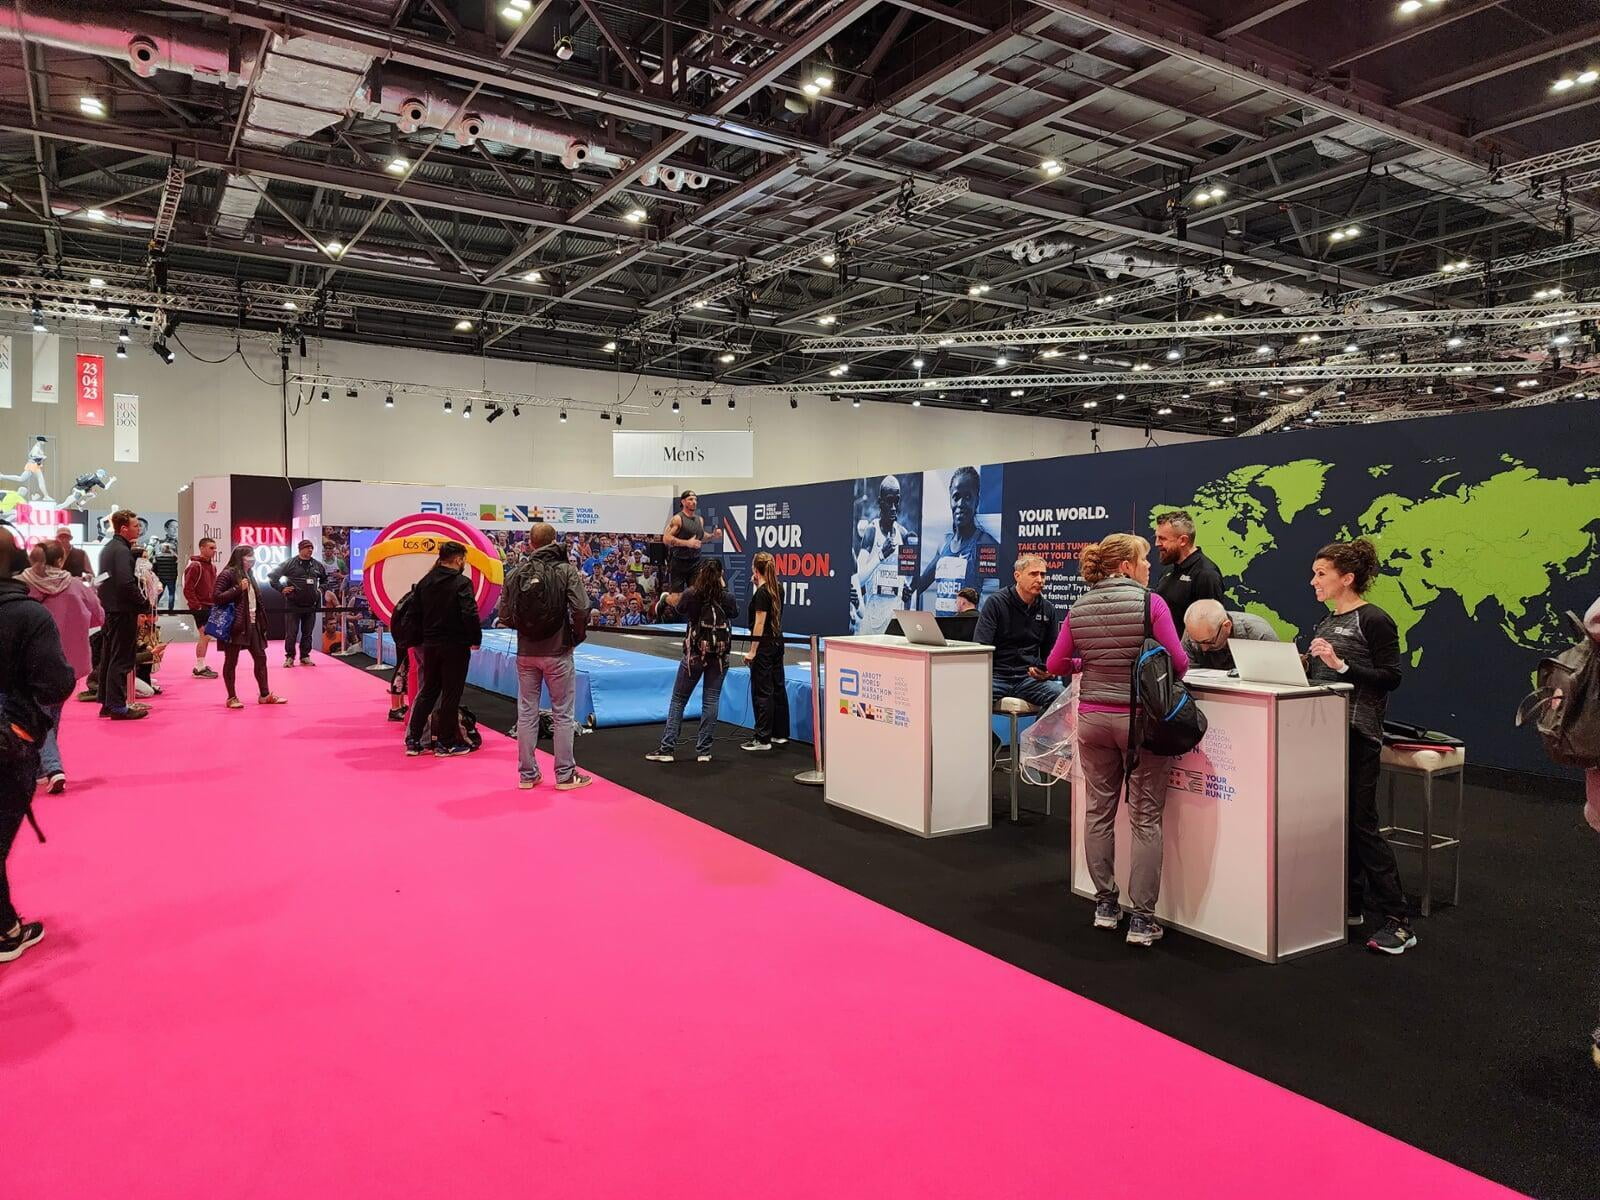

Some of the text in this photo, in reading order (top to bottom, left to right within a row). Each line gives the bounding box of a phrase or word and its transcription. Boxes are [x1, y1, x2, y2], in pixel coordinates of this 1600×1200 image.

[82, 362, 98, 375] 23
[82, 375, 98, 387] 04
[83, 387, 98, 400] 23
[664, 446, 705, 461] Men's
[1018, 506, 1109, 523] YOUR WORLD.
[203, 523, 222, 540] Run
[239, 526, 287, 546] RUN
[755, 525, 802, 548] YOUR
[1018, 523, 1061, 537] RUN IT.
[1018, 543, 1037, 551] TAKE
[1037, 542, 1049, 550] ON
[1050, 542, 1065, 550] THE
[254, 545, 287, 563] ON
[1050, 552, 1072, 560] YOUR
[773, 553, 835, 578] NDON.
[791, 582, 811, 606] IT.
[1072, 584, 1083, 593] Try
[1048, 592, 1069, 600] fastest
[1205, 774, 1227, 784] YOUR
[1205, 782, 1236, 794] WORLD.
[1205, 790, 1233, 801] RUN IT.
